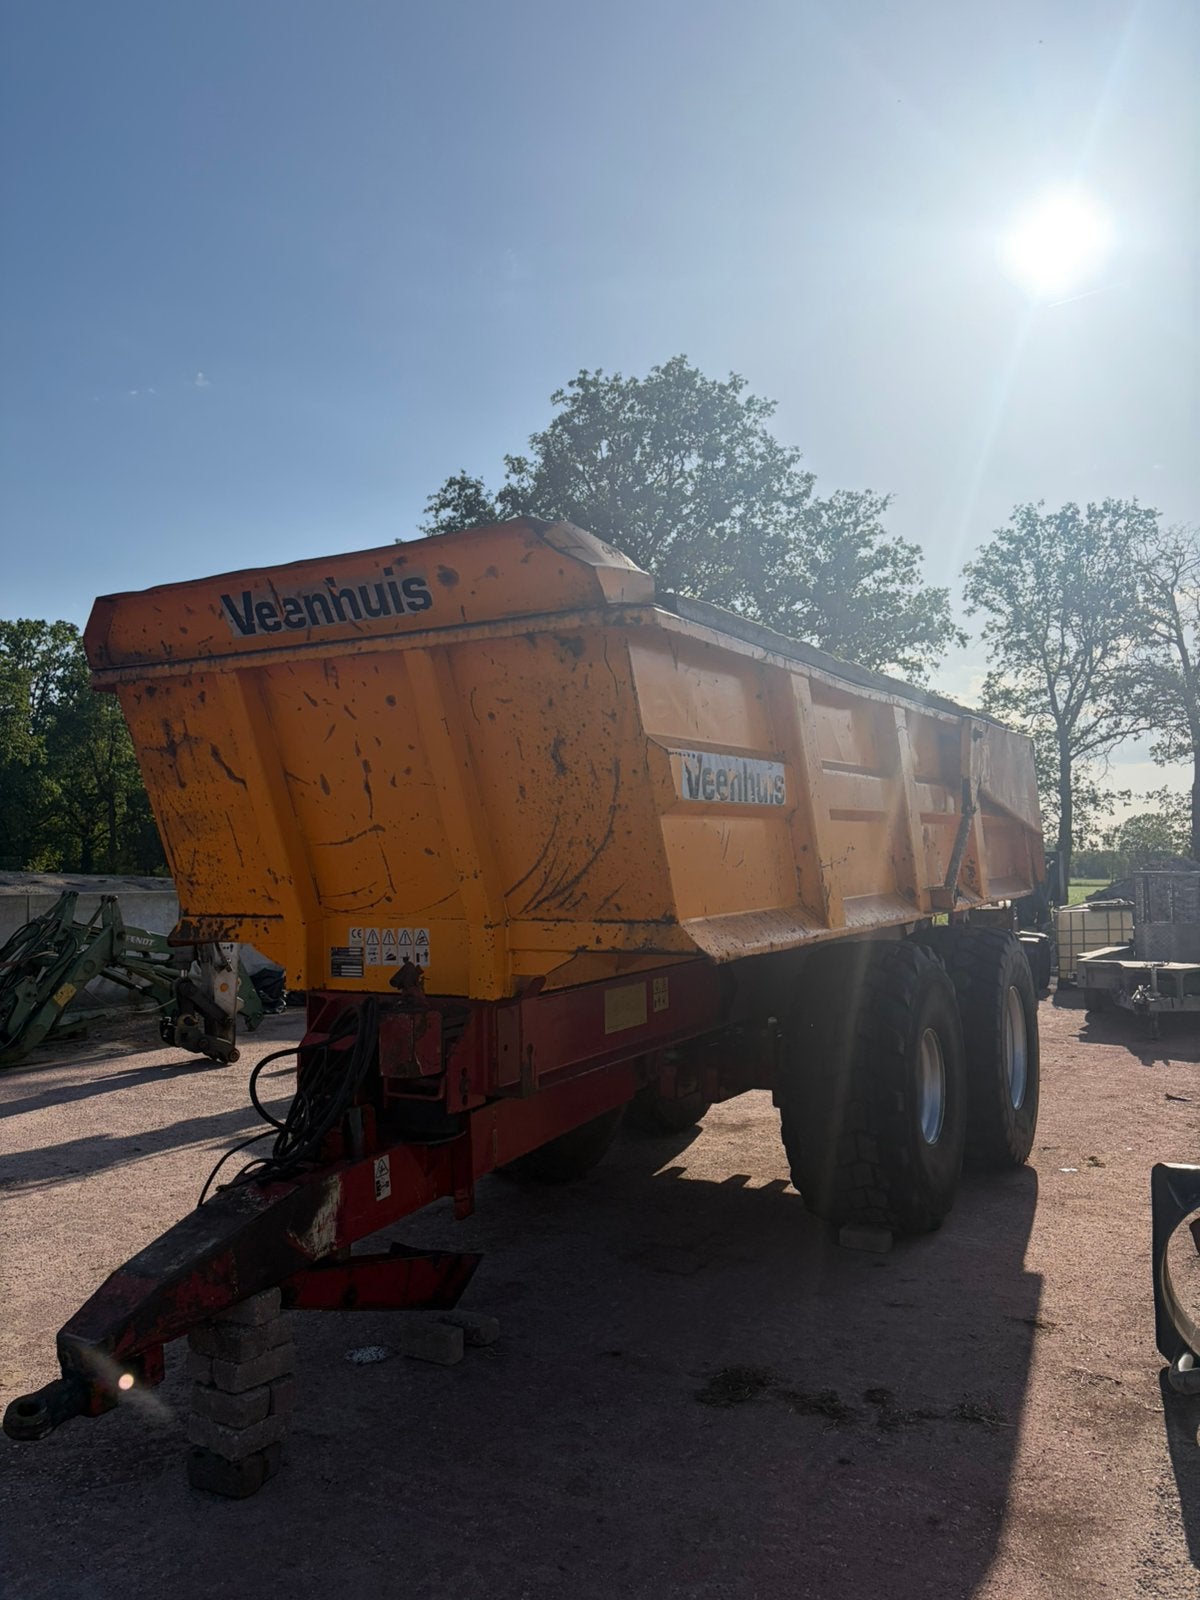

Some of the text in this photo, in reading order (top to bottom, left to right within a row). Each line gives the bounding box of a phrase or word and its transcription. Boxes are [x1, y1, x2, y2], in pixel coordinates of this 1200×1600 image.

[220, 567, 433, 636] Veenhuis
[351, 928, 362, 939] CE
[125, 935, 156, 947] FENDT
